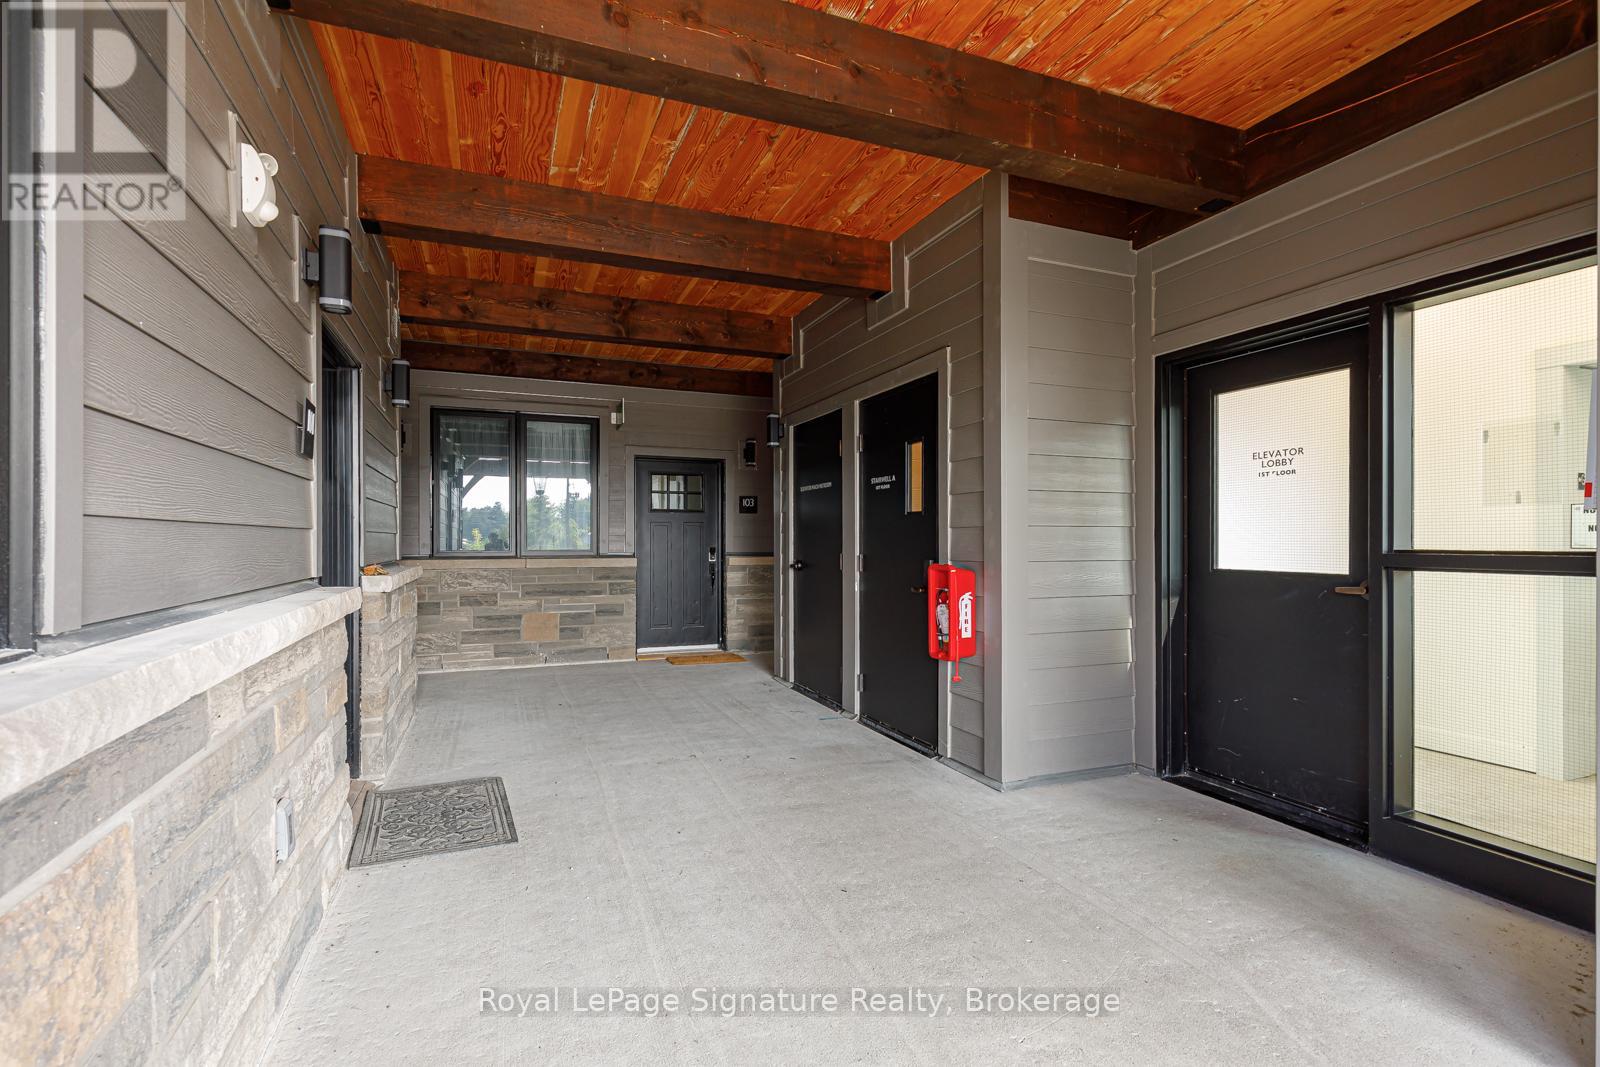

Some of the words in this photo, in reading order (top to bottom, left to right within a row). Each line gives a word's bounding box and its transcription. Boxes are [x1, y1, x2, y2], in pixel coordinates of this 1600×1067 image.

[1252, 447, 1304, 460] ELEVATOR
[1261, 457, 1294, 468] LOBBY
[742, 498, 754, 507] 103
